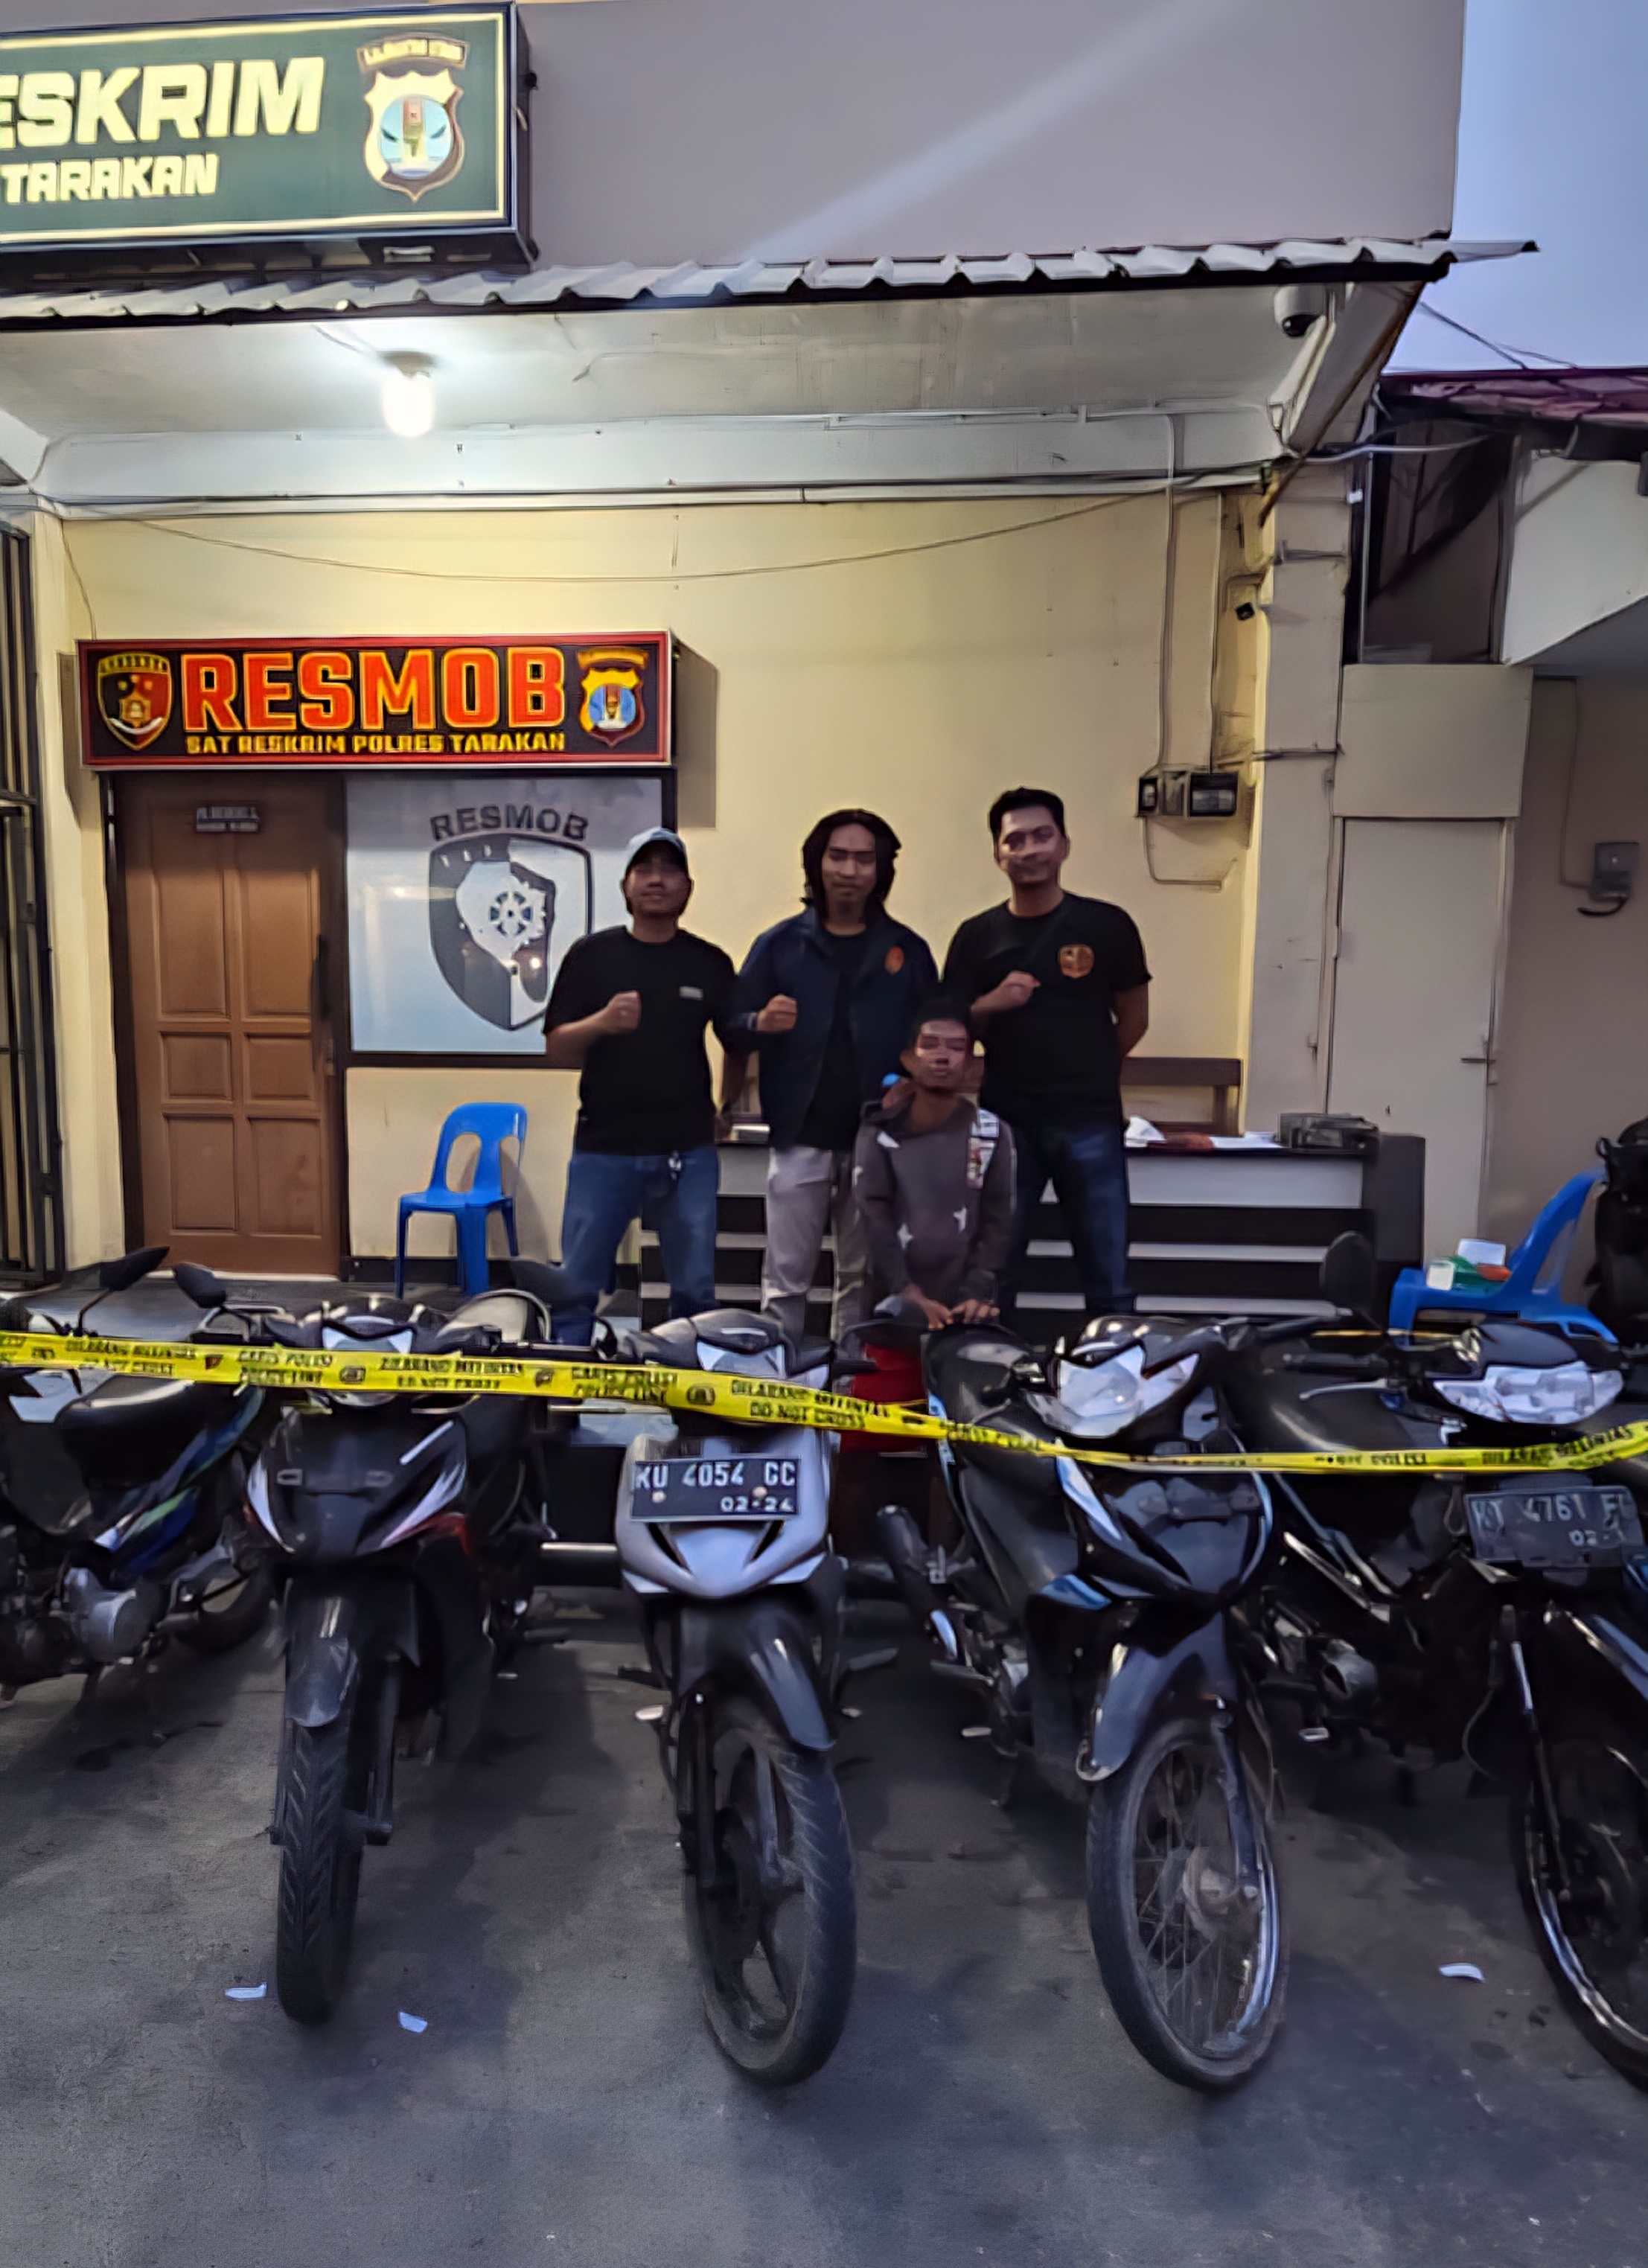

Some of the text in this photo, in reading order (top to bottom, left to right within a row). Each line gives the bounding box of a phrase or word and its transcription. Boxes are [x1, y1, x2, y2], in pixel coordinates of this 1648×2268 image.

[1, 153, 220, 205] TARAKAN
[181, 647, 565, 732] RESMOB
[430, 803, 589, 842] RESMOB
[682, 1461, 744, 1487] 4054
